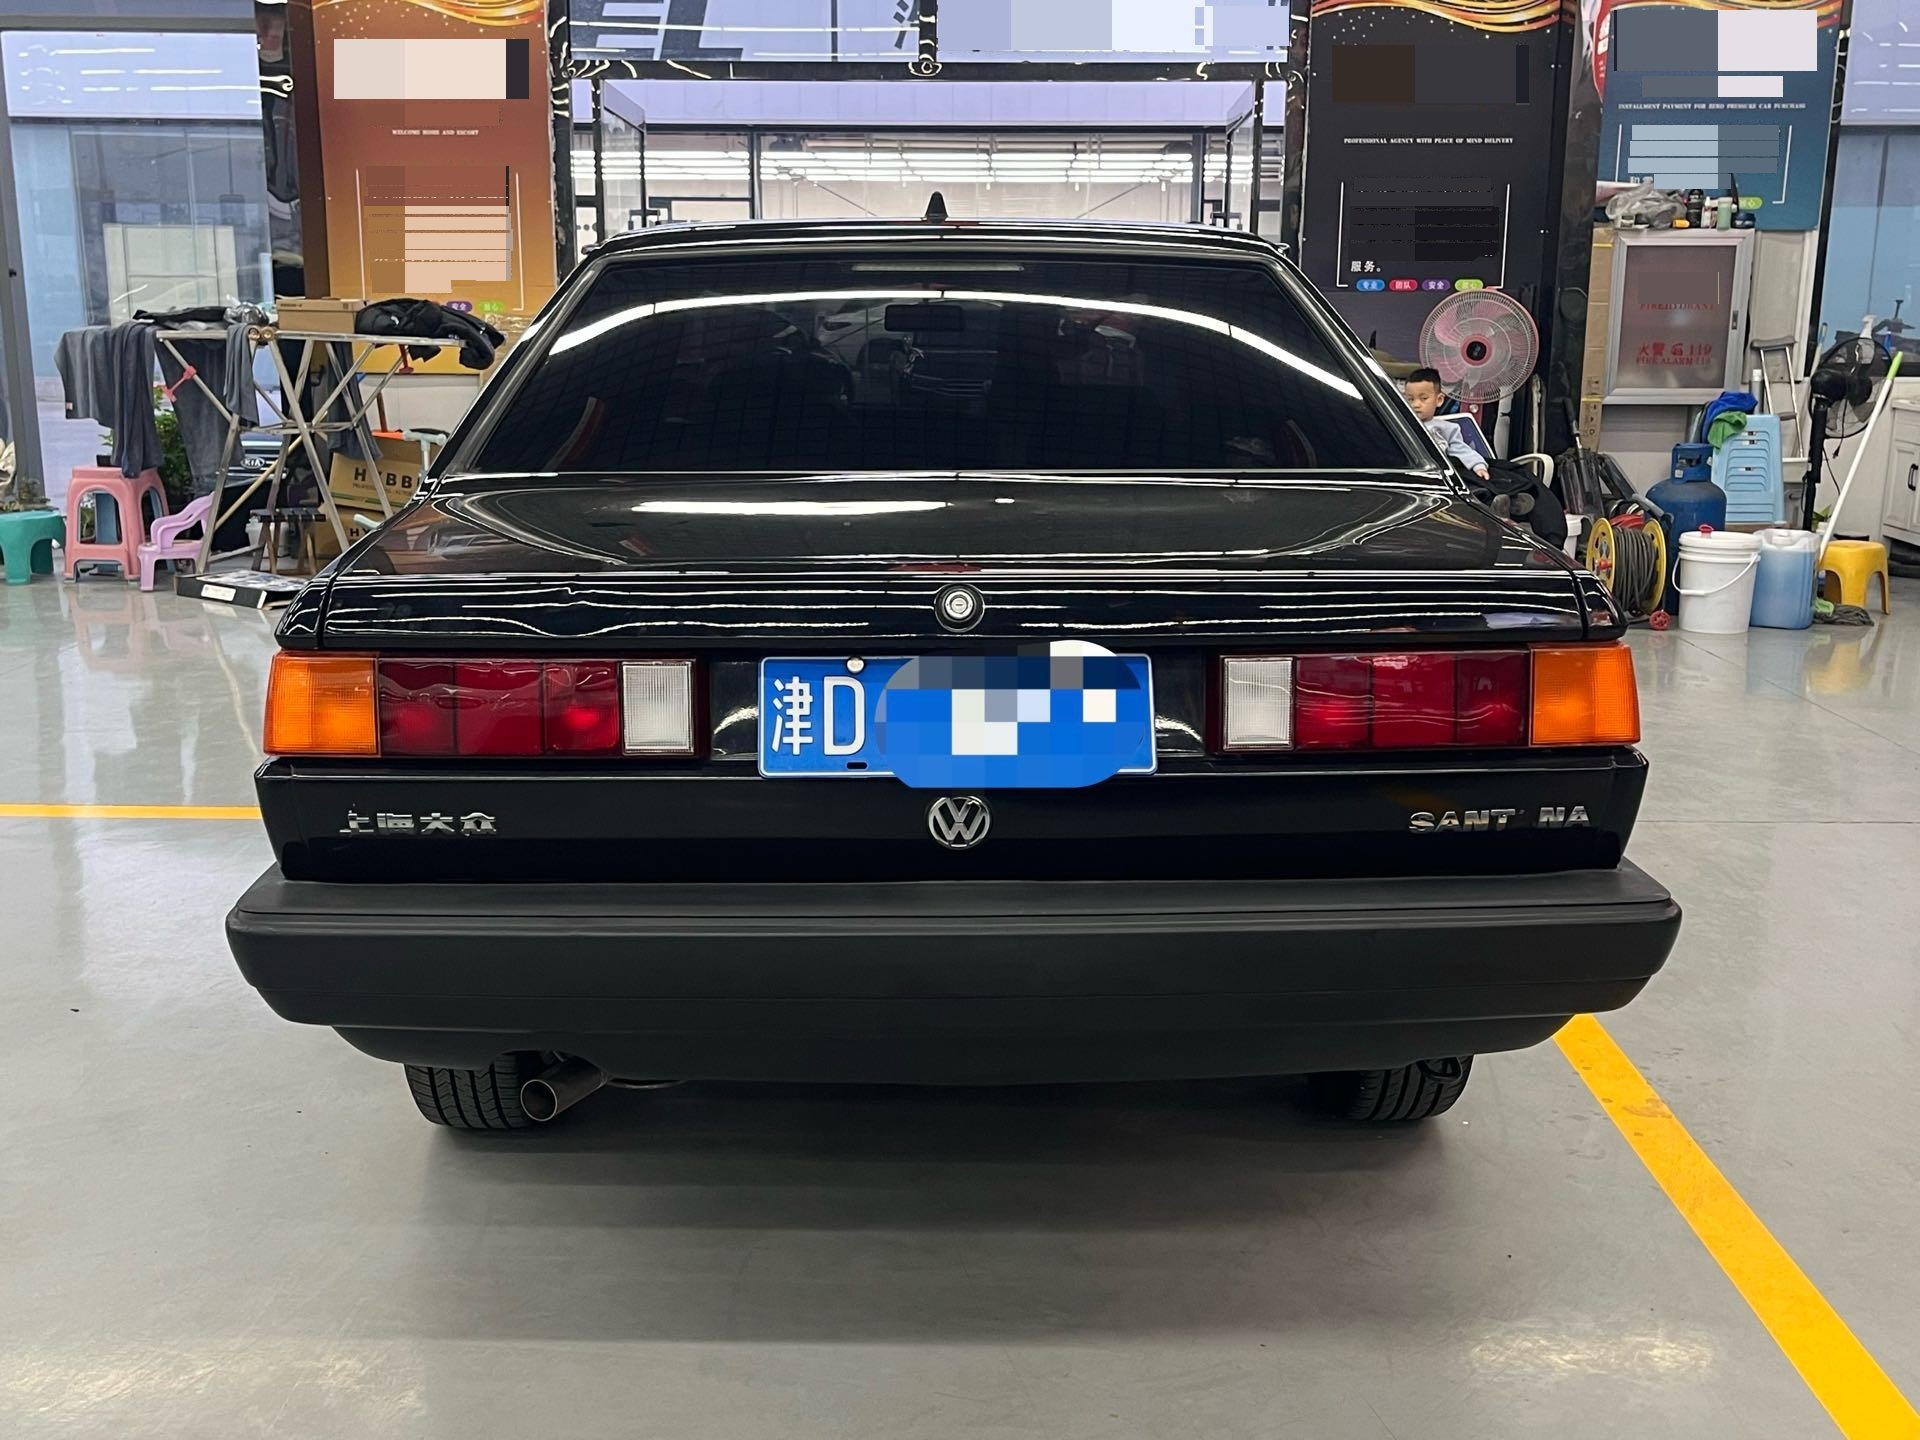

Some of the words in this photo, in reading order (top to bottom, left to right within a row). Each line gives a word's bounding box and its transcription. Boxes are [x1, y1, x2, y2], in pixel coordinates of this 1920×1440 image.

[1350, 261, 1381, 272] 服务。
[1395, 280, 1412, 290] 团队
[1428, 280, 1445, 290] 安全
[1690, 344, 1712, 356] 119
[339, 812, 497, 836] 上海大众
